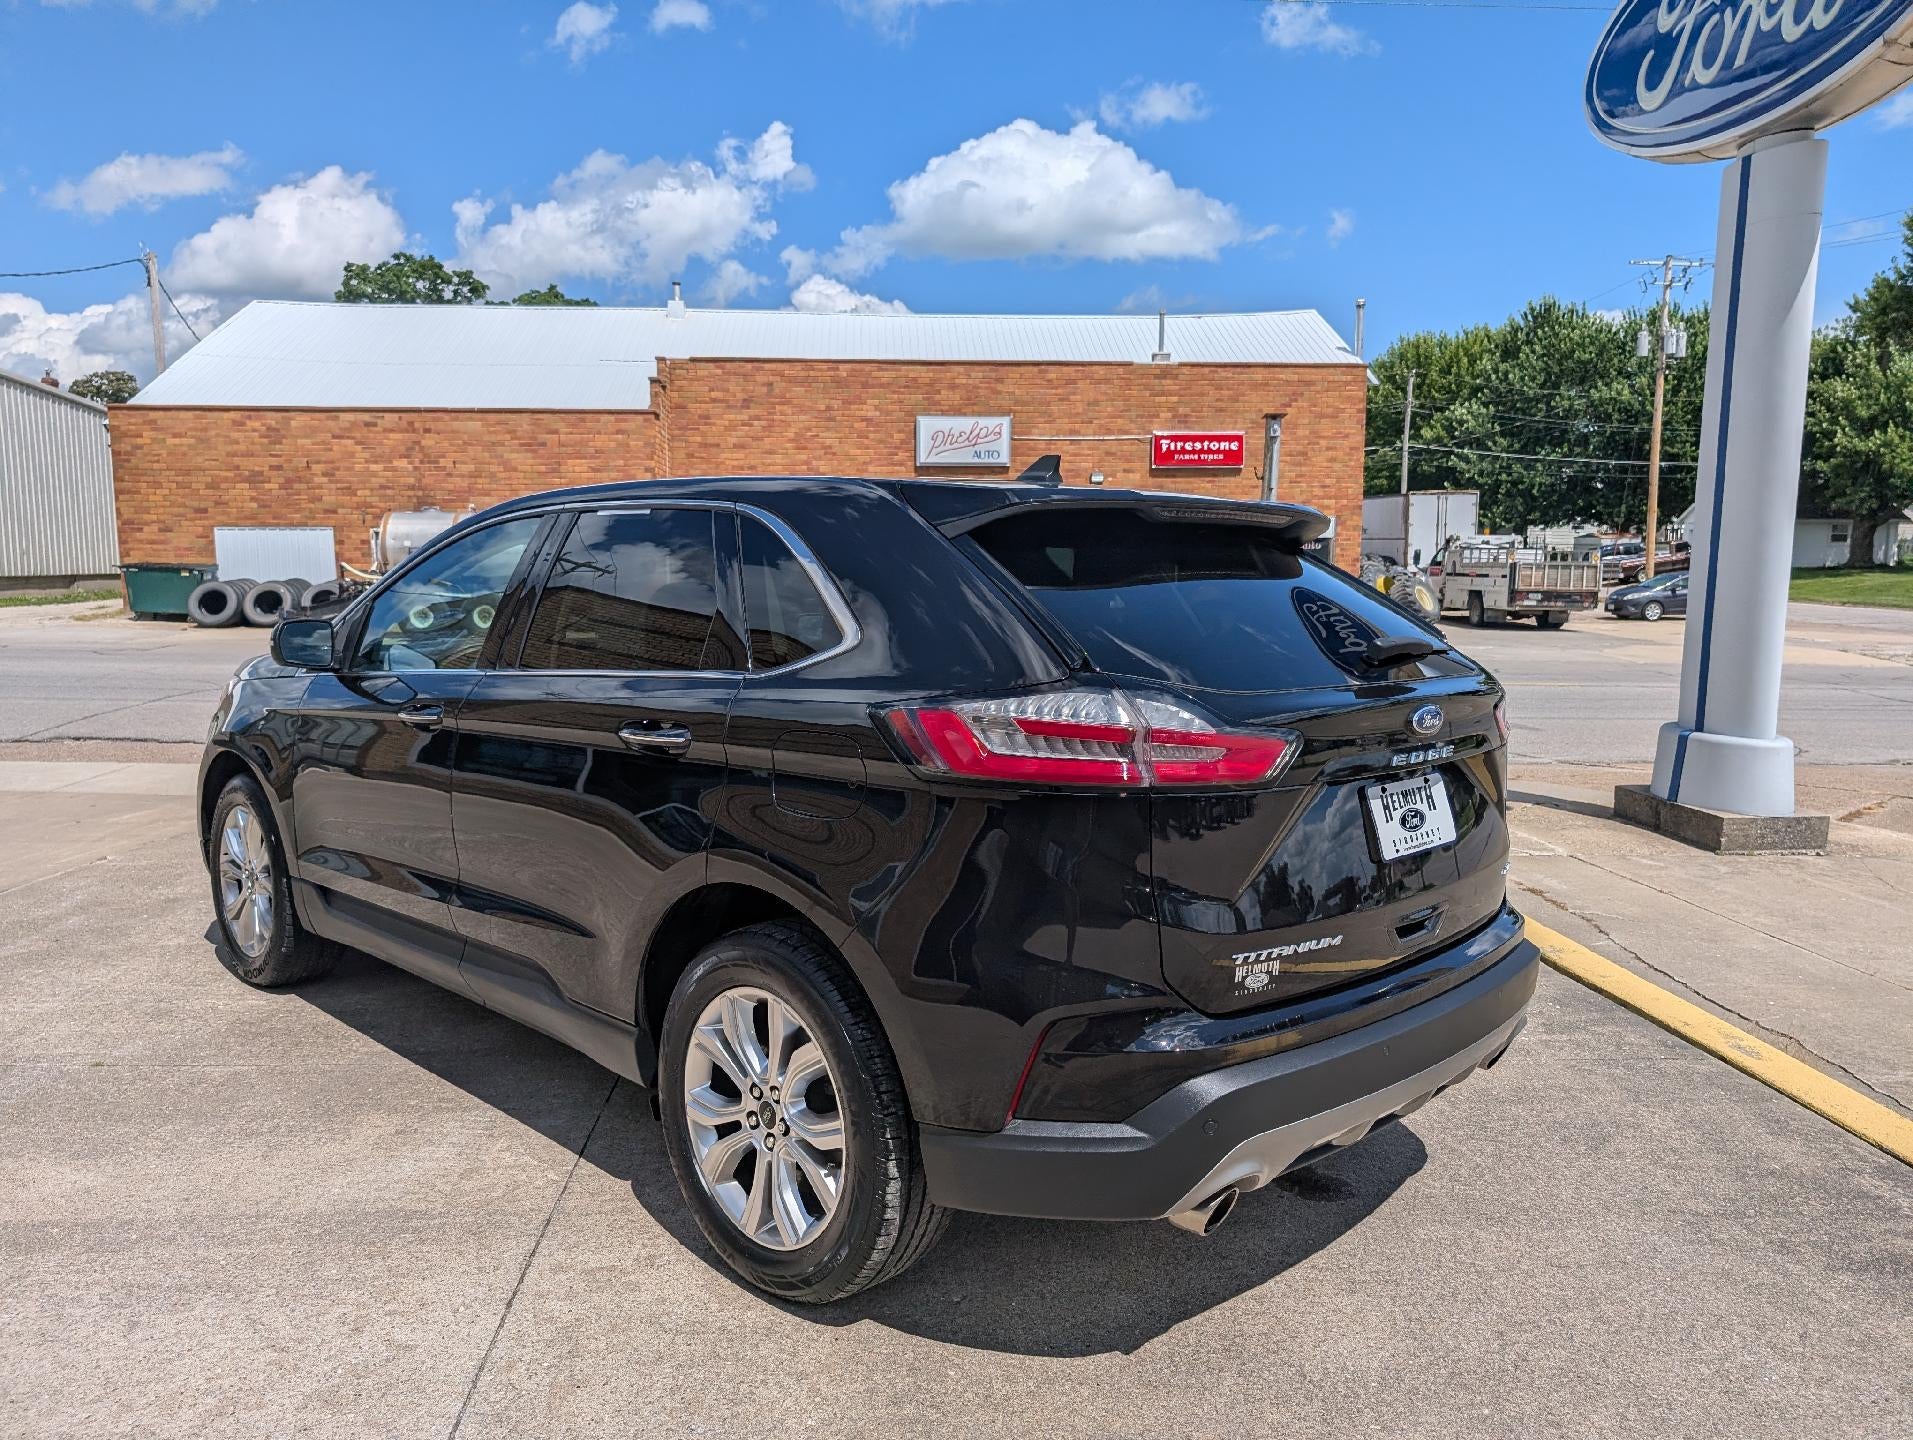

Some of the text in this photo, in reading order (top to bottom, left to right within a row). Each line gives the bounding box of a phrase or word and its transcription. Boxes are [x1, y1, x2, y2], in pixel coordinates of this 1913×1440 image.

[925, 420, 1004, 461] Phelps
[1160, 439, 1239, 454] Firestone
[972, 449, 1001, 460] AUTO
[1422, 712, 1440, 728] Ford
[1391, 745, 1455, 767] EDGE
[1380, 784, 1437, 823] HELMUTH
[1404, 811, 1423, 829] Ford
[1231, 934, 1344, 965] TITANIUM
[1234, 960, 1280, 983] HELMUTH
